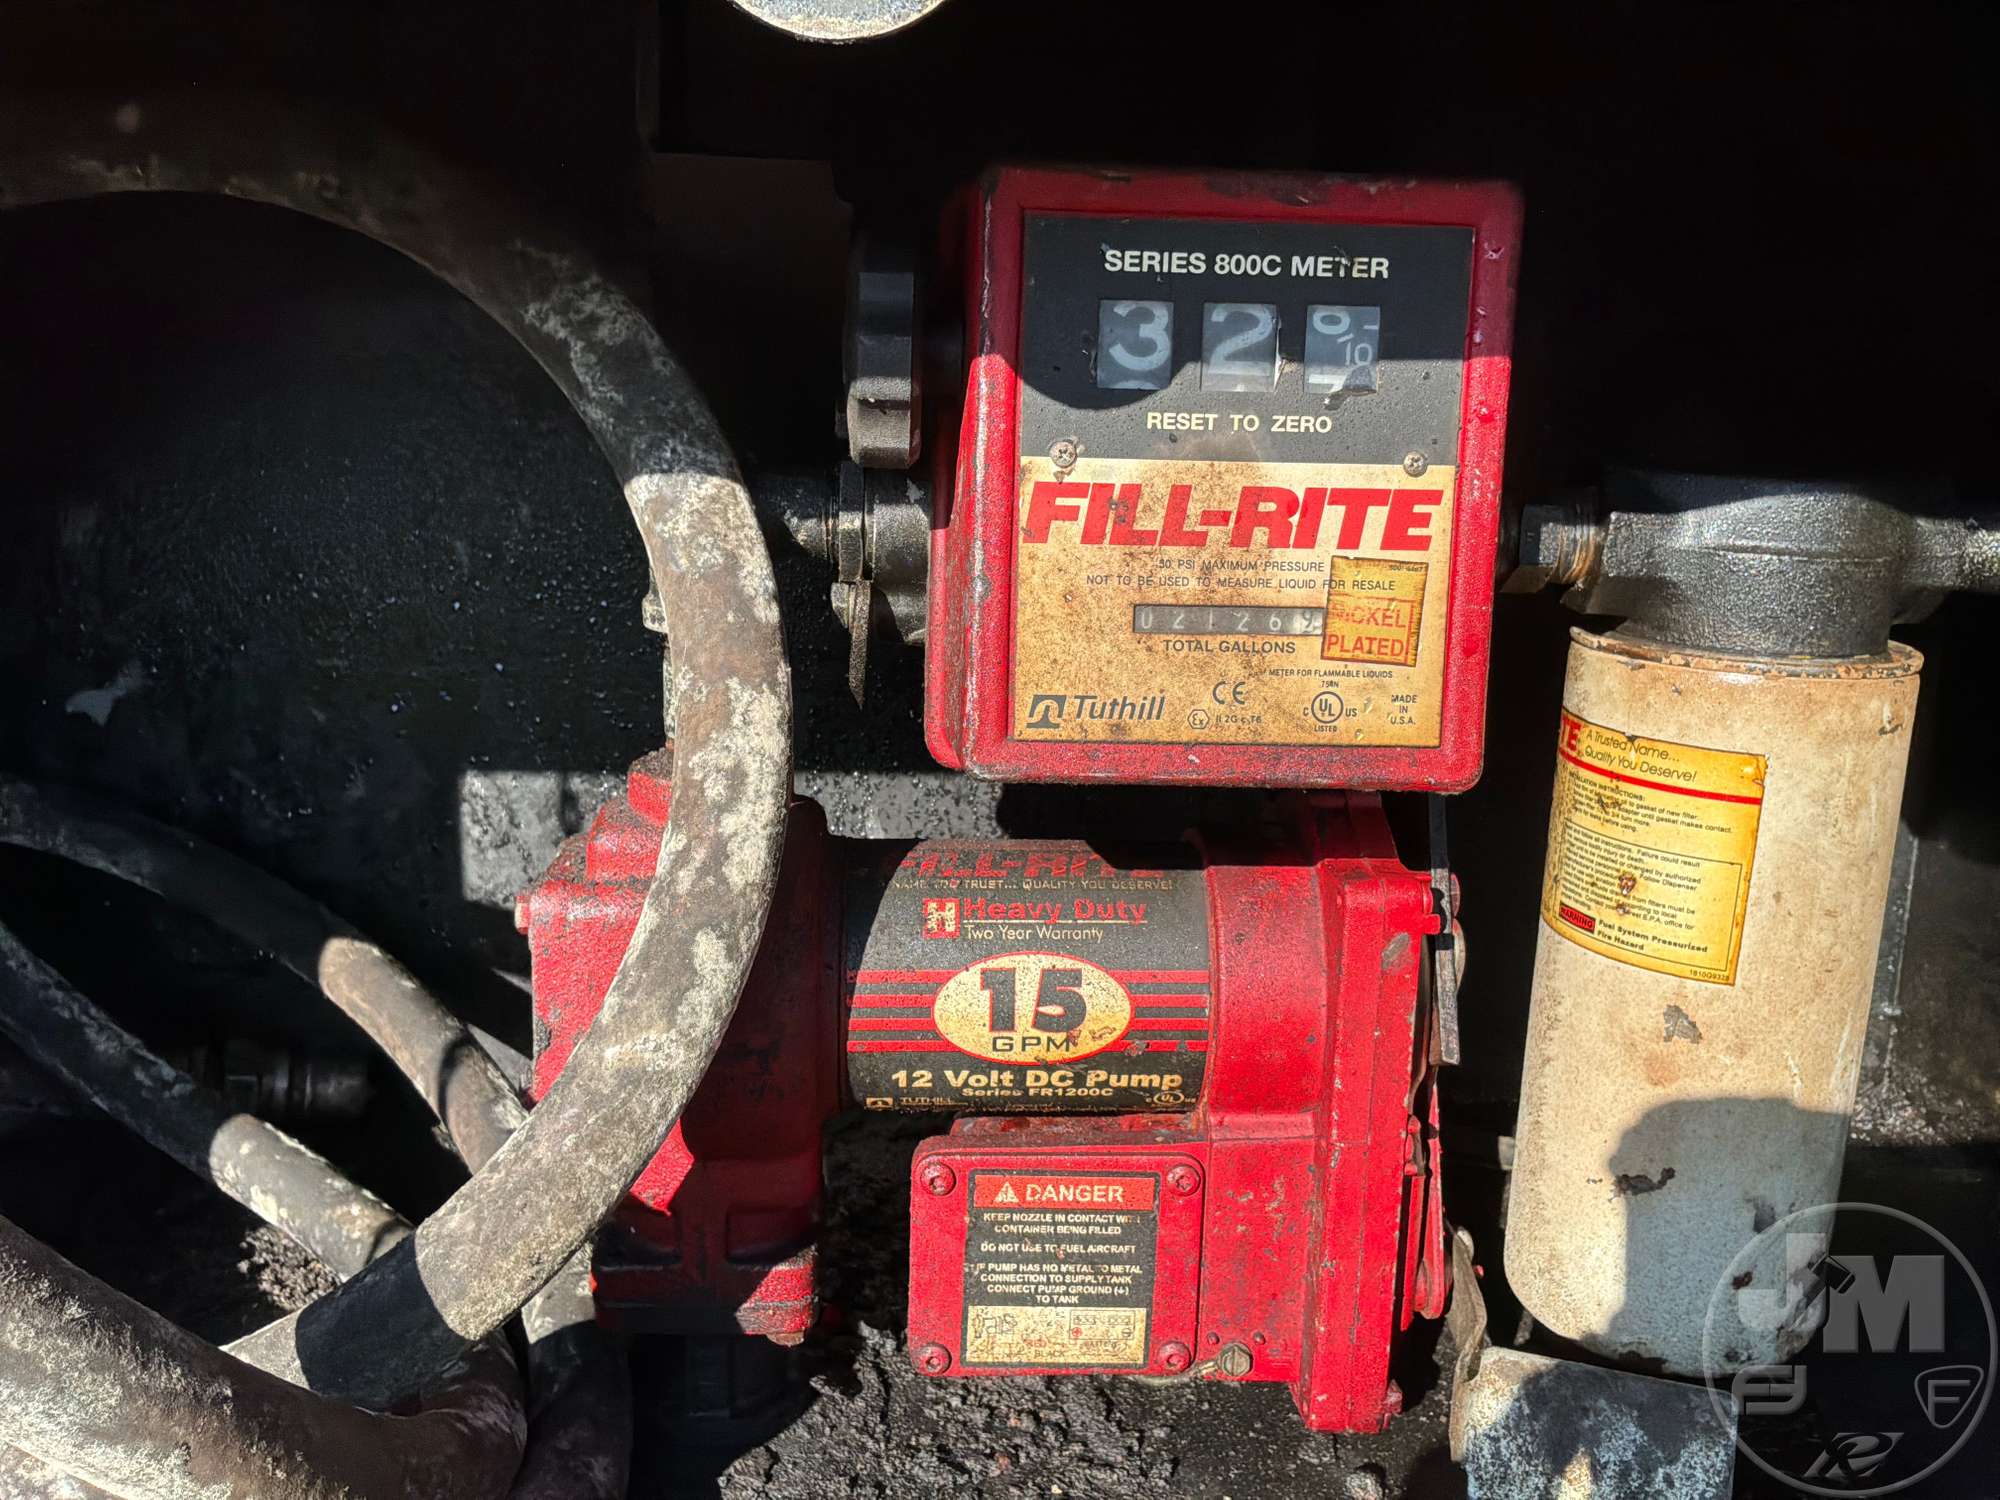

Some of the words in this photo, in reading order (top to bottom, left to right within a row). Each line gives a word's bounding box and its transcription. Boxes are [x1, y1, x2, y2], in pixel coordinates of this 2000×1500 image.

[1105, 250, 1206, 274] SERIES
[1214, 254, 1282, 277] 800C
[1291, 256, 1390, 279] METER
[1147, 412, 1217, 431] RESET
[1231, 414, 1260, 432] TO
[1271, 415, 1333, 434] ZERO
[1022, 481, 1443, 551] FILL-RITE
[1178, 559, 1196, 569] PSI
[1201, 559, 1258, 572] MAXIMUM
[1265, 561, 1325, 572] PRESSURE
[1086, 575, 1109, 586] NOT
[1116, 575, 1131, 586] TO
[1138, 576, 1153, 586] BE
[1159, 576, 1190, 587] USED
[1196, 577, 1211, 588] TO
[1218, 577, 1272, 588] MEASURE
[1279, 578, 1317, 589] LIQUID
[1322, 579, 1345, 590] FOR
[1352, 580, 1396, 591] RESALE
[1163, 639, 1214, 652] TOTAL
[1219, 640, 1296, 654] GALLONS
[1327, 634, 1405, 656] PLATED
[1297, 669, 1312, 677] FOR
[1314, 669, 1360, 678] FLAMMABLE
[1362, 670, 1393, 679] LIQUIDS
[1391, 695, 1418, 704] MADE
[1074, 694, 1166, 721] Tuthill
[1399, 706, 1409, 714] IN
[1390, 716, 1416, 726] U.S.A.
[1585, 729, 1593, 739] A
[1595, 731, 1628, 751] Trusted
[1629, 742, 1680, 762] Name...
[1585, 745, 1616, 766] Quality
[1618, 755, 1637, 770] You
[1639, 761, 1697, 783] Deserve!
[1023, 879, 1076, 891] QUALITY
[963, 898, 1063, 925] Heavy
[1074, 898, 1147, 925] Duty
[964, 924, 994, 939] Two
[998, 924, 1033, 940] Year
[1035, 925, 1104, 943] Warranty
[1597, 928, 1612, 942] Fire
[1598, 917, 1615, 931] Fuel
[1617, 924, 1649, 942] System
[1651, 933, 1708, 953] Pressurized
[980, 967, 1088, 1034] 15
[992, 1035, 1073, 1053] GPM
[892, 1070, 933, 1088] 12
[944, 1069, 1015, 1088] Volt
[1025, 1069, 1075, 1088] DC
[1085, 1069, 1183, 1091] Pump
[962, 1087, 1024, 1097] Series
[1028, 1087, 1114, 1097] FR1200C
[1025, 1184, 1124, 1203] DANGER
[1012, 1213, 1053, 1223] NOZZLE
[1054, 1214, 1065, 1223] IN
[1067, 1214, 1115, 1223] CONTACT
[994, 1225, 1056, 1234] CONTAINER
[1057, 1226, 1087, 1234] BEING
[1088, 1226, 1122, 1235] FILLED
[981, 1241, 996, 1252] DO
[998, 1243, 1020, 1252] NOT
[1087, 1245, 1137, 1254] AIRCRAFT
[988, 1263, 1018, 1272] PUMP
[1019, 1264, 1041, 1272] HAS
[1042, 1264, 1058, 1272] NO
[1110, 1265, 1143, 1274] METAL
[980, 1274, 1047, 1283] CONNECTION
[1049, 1274, 1063, 1283] TO
[1064, 1275, 1103, 1284] SUPPLY
[1103, 1275, 1133, 1284] TANK
[987, 1284, 1036, 1293] CONNECT
[1038, 1285, 1067, 1294] PUMP
[1069, 1285, 1112, 1294] GROUND
[1035, 1295, 1051, 1304] TO
[1051, 1295, 1079, 1304] TANK
